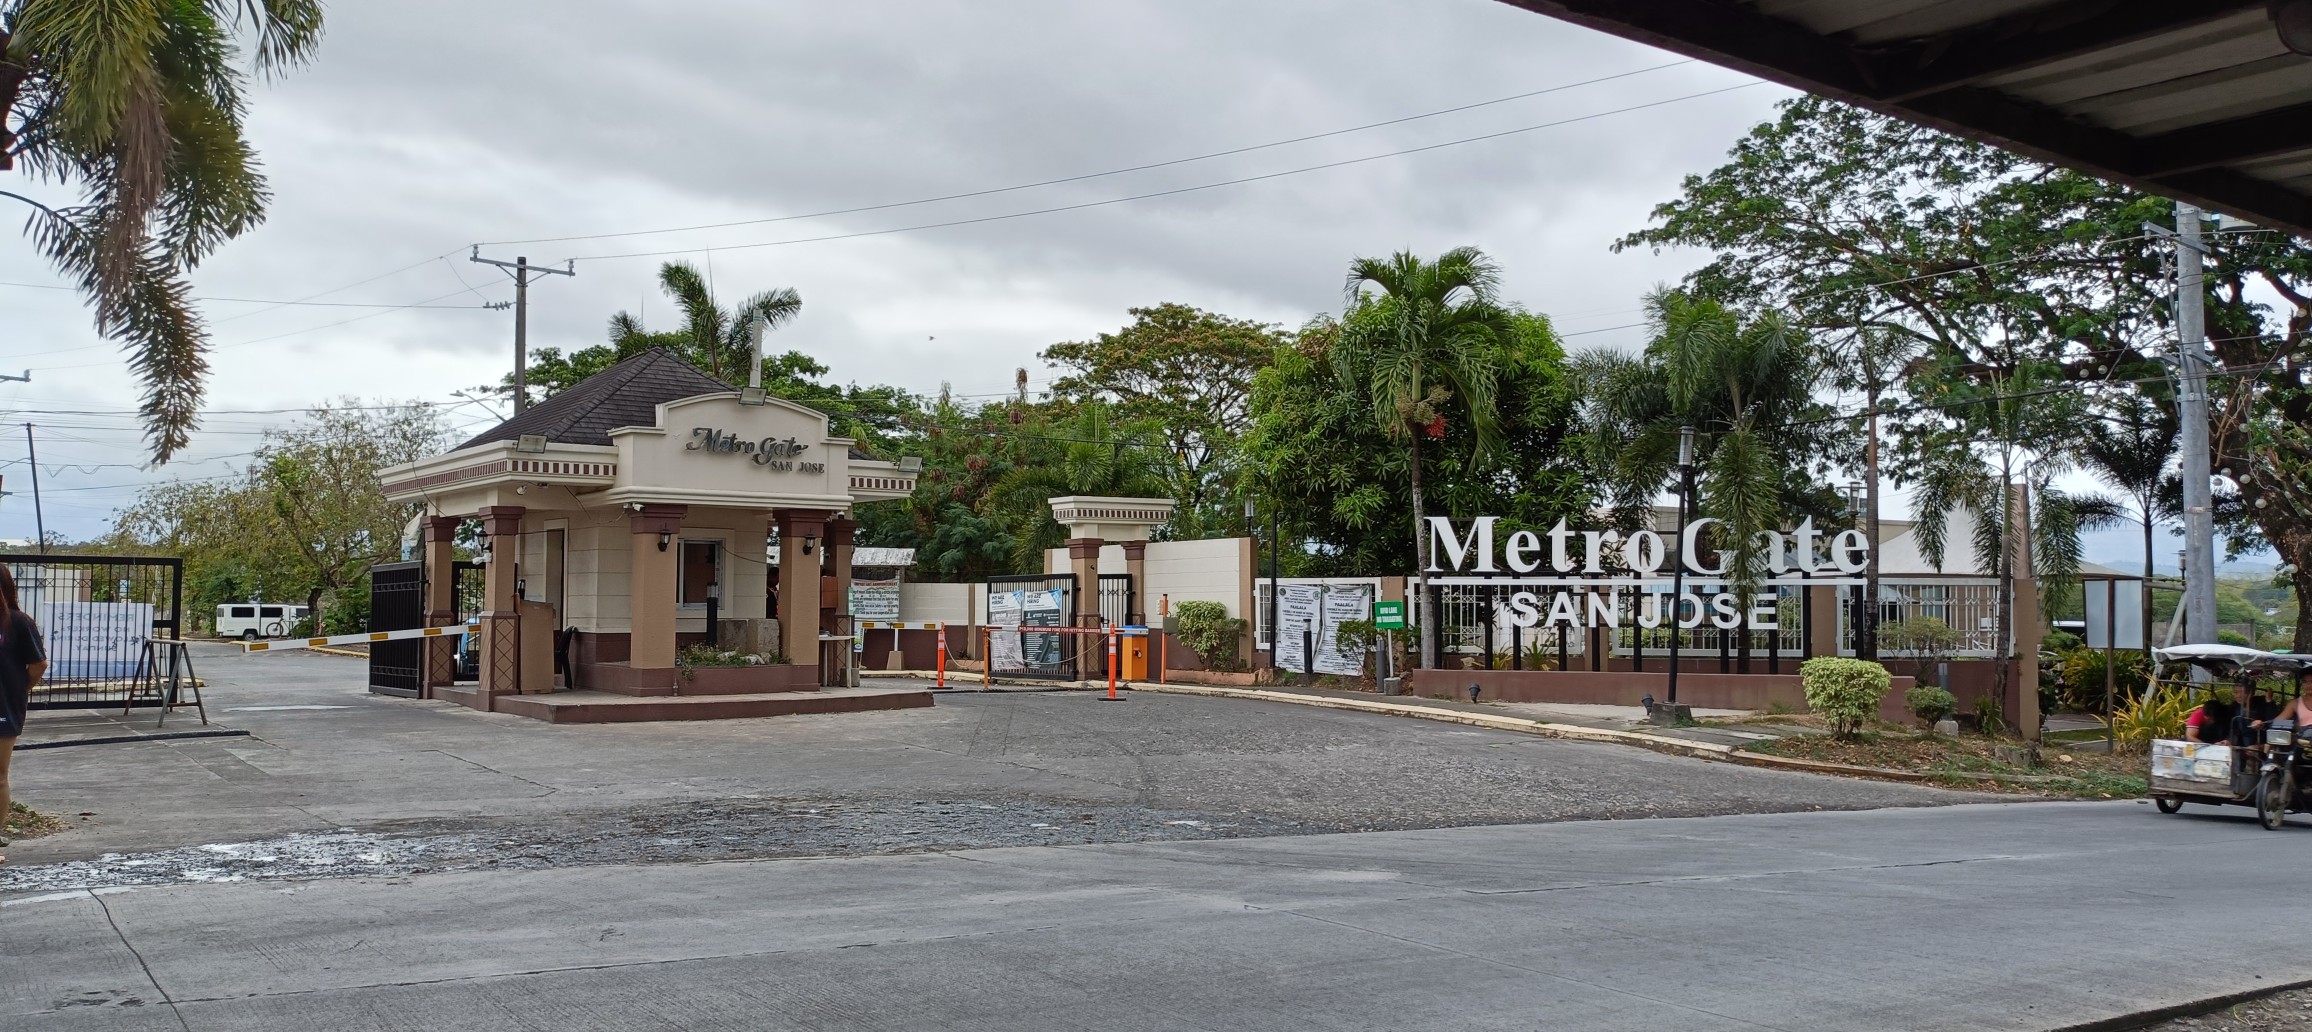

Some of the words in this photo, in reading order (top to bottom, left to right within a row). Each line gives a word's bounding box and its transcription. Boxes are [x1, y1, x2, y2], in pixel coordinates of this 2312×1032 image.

[686, 427, 756, 454] Metro
[752, 437, 809, 466] Gate
[771, 461, 793, 472] SAN
[799, 461, 825, 474] JOSE
[1423, 515, 1665, 574] Metro
[1682, 514, 1870, 575] Gate
[1510, 591, 1619, 629] SAN
[1637, 592, 1779, 630] JOSE
